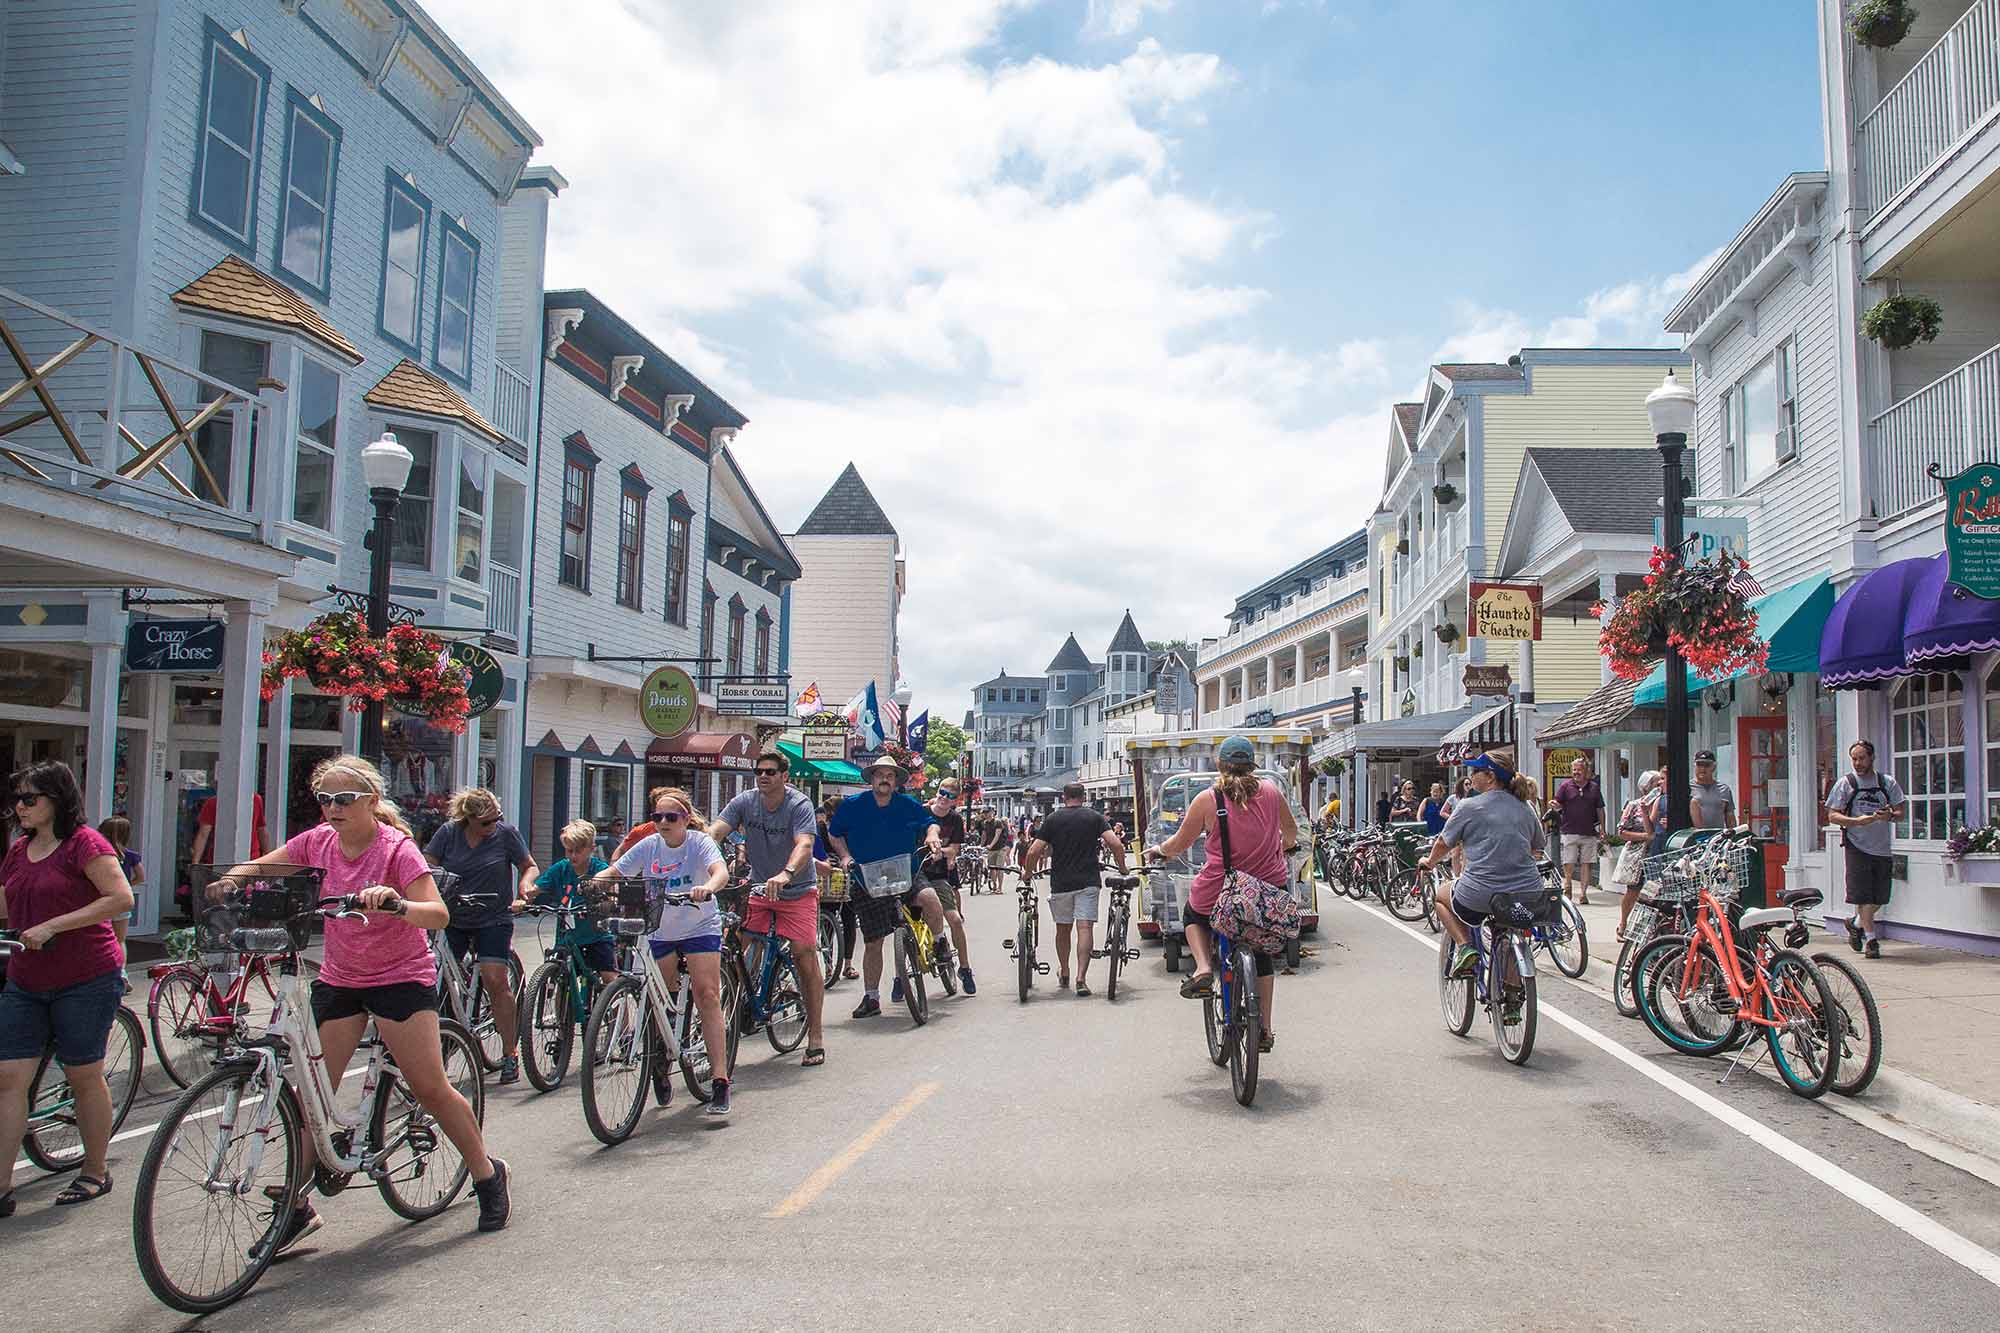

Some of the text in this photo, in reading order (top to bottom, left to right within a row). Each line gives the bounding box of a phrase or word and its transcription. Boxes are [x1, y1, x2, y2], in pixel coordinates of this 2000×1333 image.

[1966, 525, 1988, 533] GIFT
[1497, 591, 1513, 601] The
[1478, 601, 1531, 621] Haunted
[146, 626, 189, 644] Crazy
[1479, 620, 1531, 638] Theatre
[168, 643, 213, 660] Horse
[462, 647, 498, 674] OUT
[722, 688, 784, 697] HORSE CORRAL
[672, 756, 697, 764] CORRAL
[699, 756, 716, 764] MALL
[721, 755, 736, 767] HORSE
